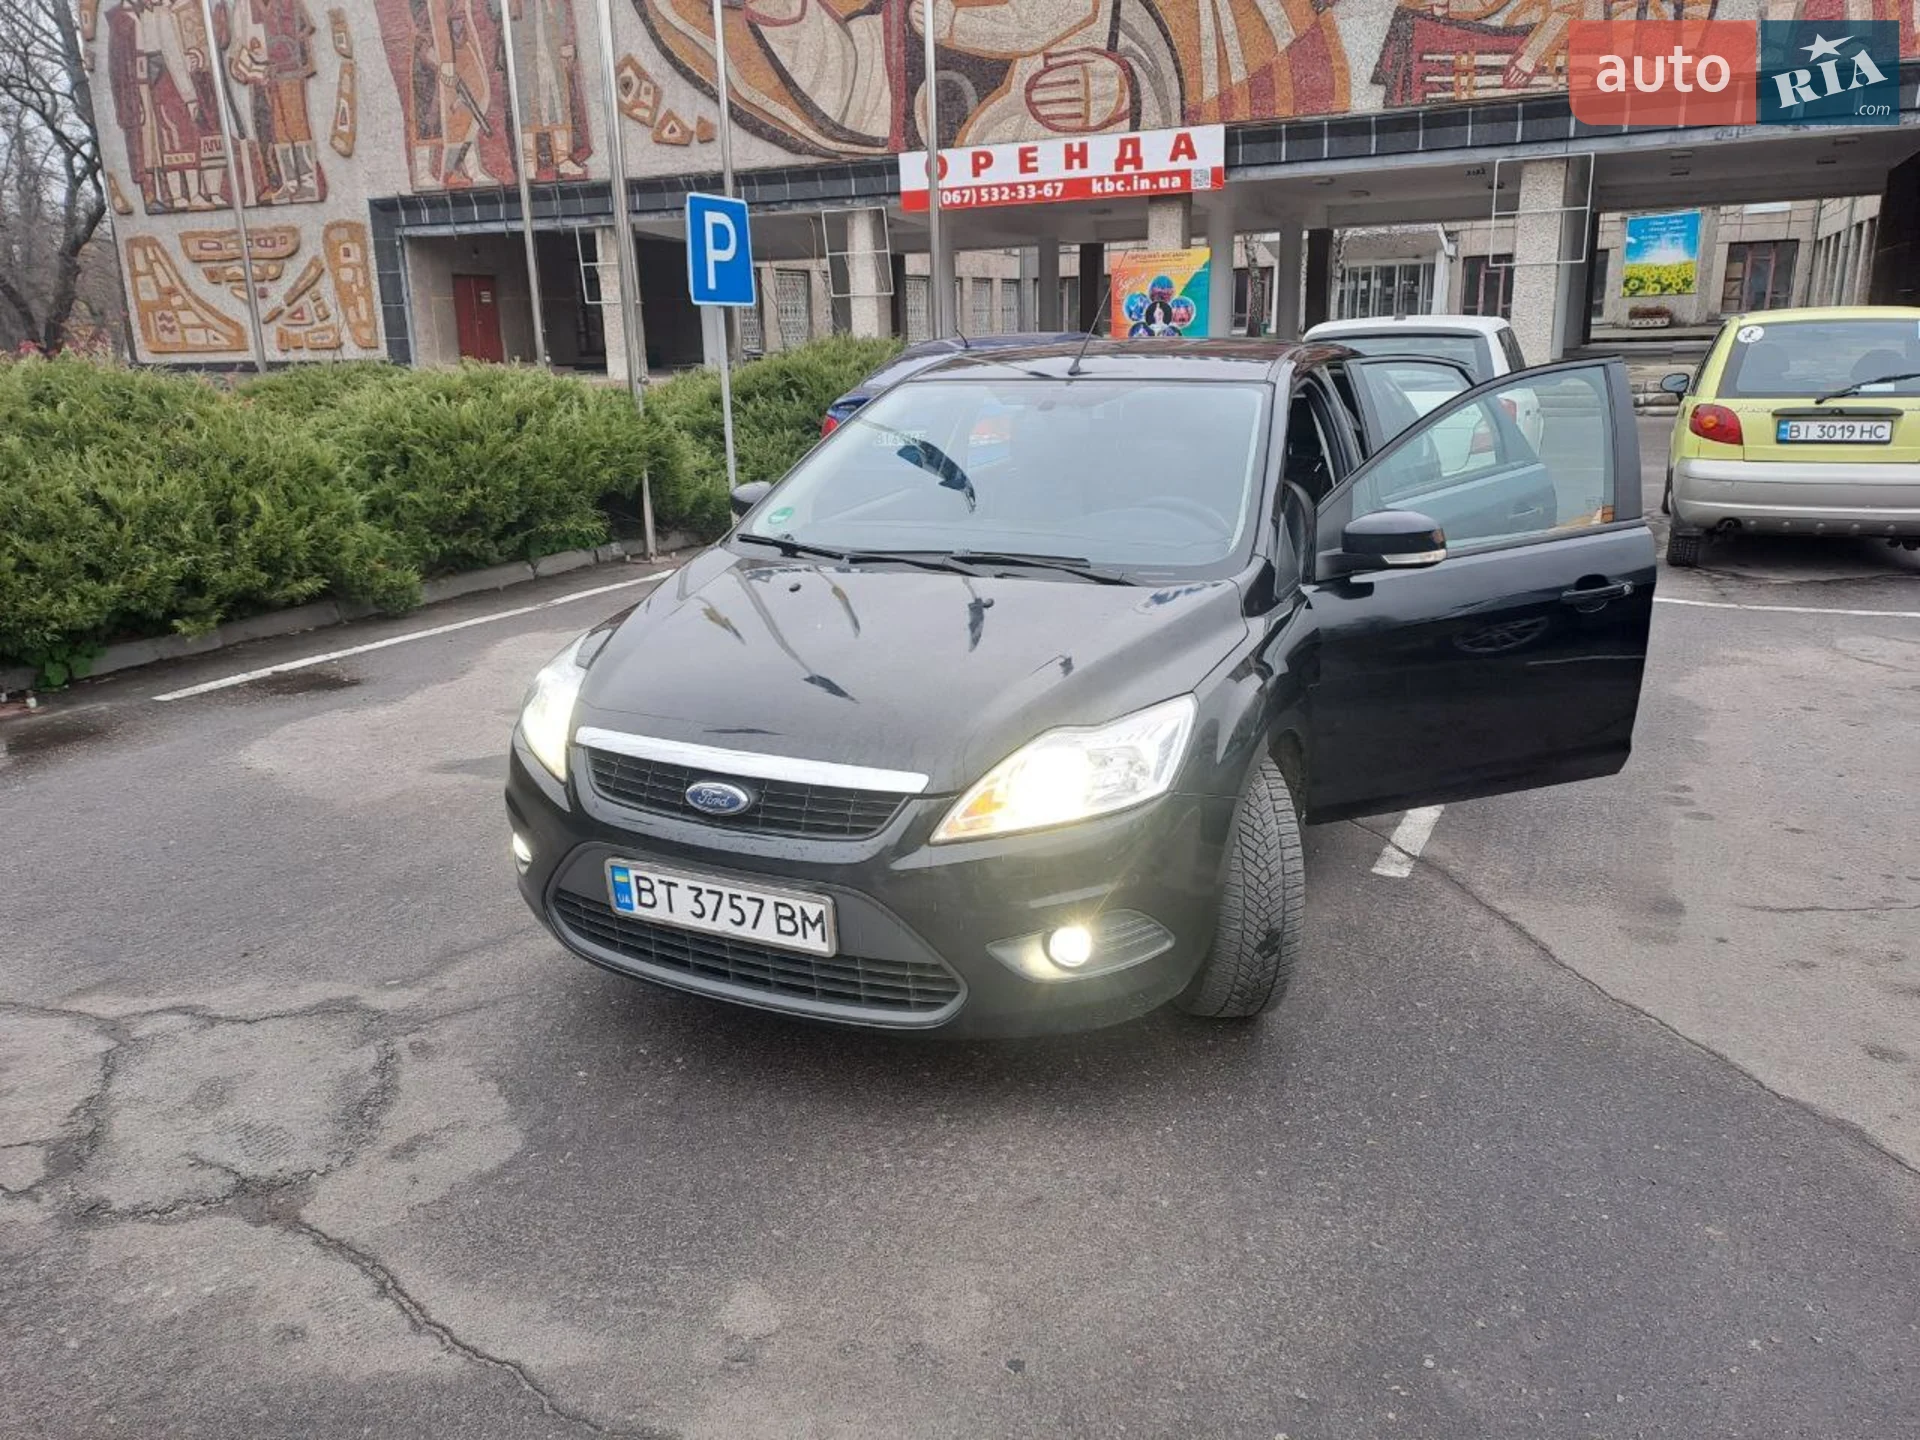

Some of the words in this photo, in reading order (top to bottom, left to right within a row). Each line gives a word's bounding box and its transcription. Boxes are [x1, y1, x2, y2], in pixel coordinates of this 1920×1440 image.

[924, 132, 1198, 181] ОРЕНДА
[980, 182, 1064, 202] 532-33-67
[1091, 174, 1182, 194] kbc.in.ua
[704, 211, 737, 290] P
[1788, 424, 1809, 439] BI
[1816, 424, 1855, 439] 3019
[1859, 424, 1886, 439] HC
[697, 788, 731, 805] Ford
[617, 893, 632, 904] UA
[634, 875, 679, 914] BT
[687, 886, 765, 930] 3757
[774, 901, 827, 943] BM
